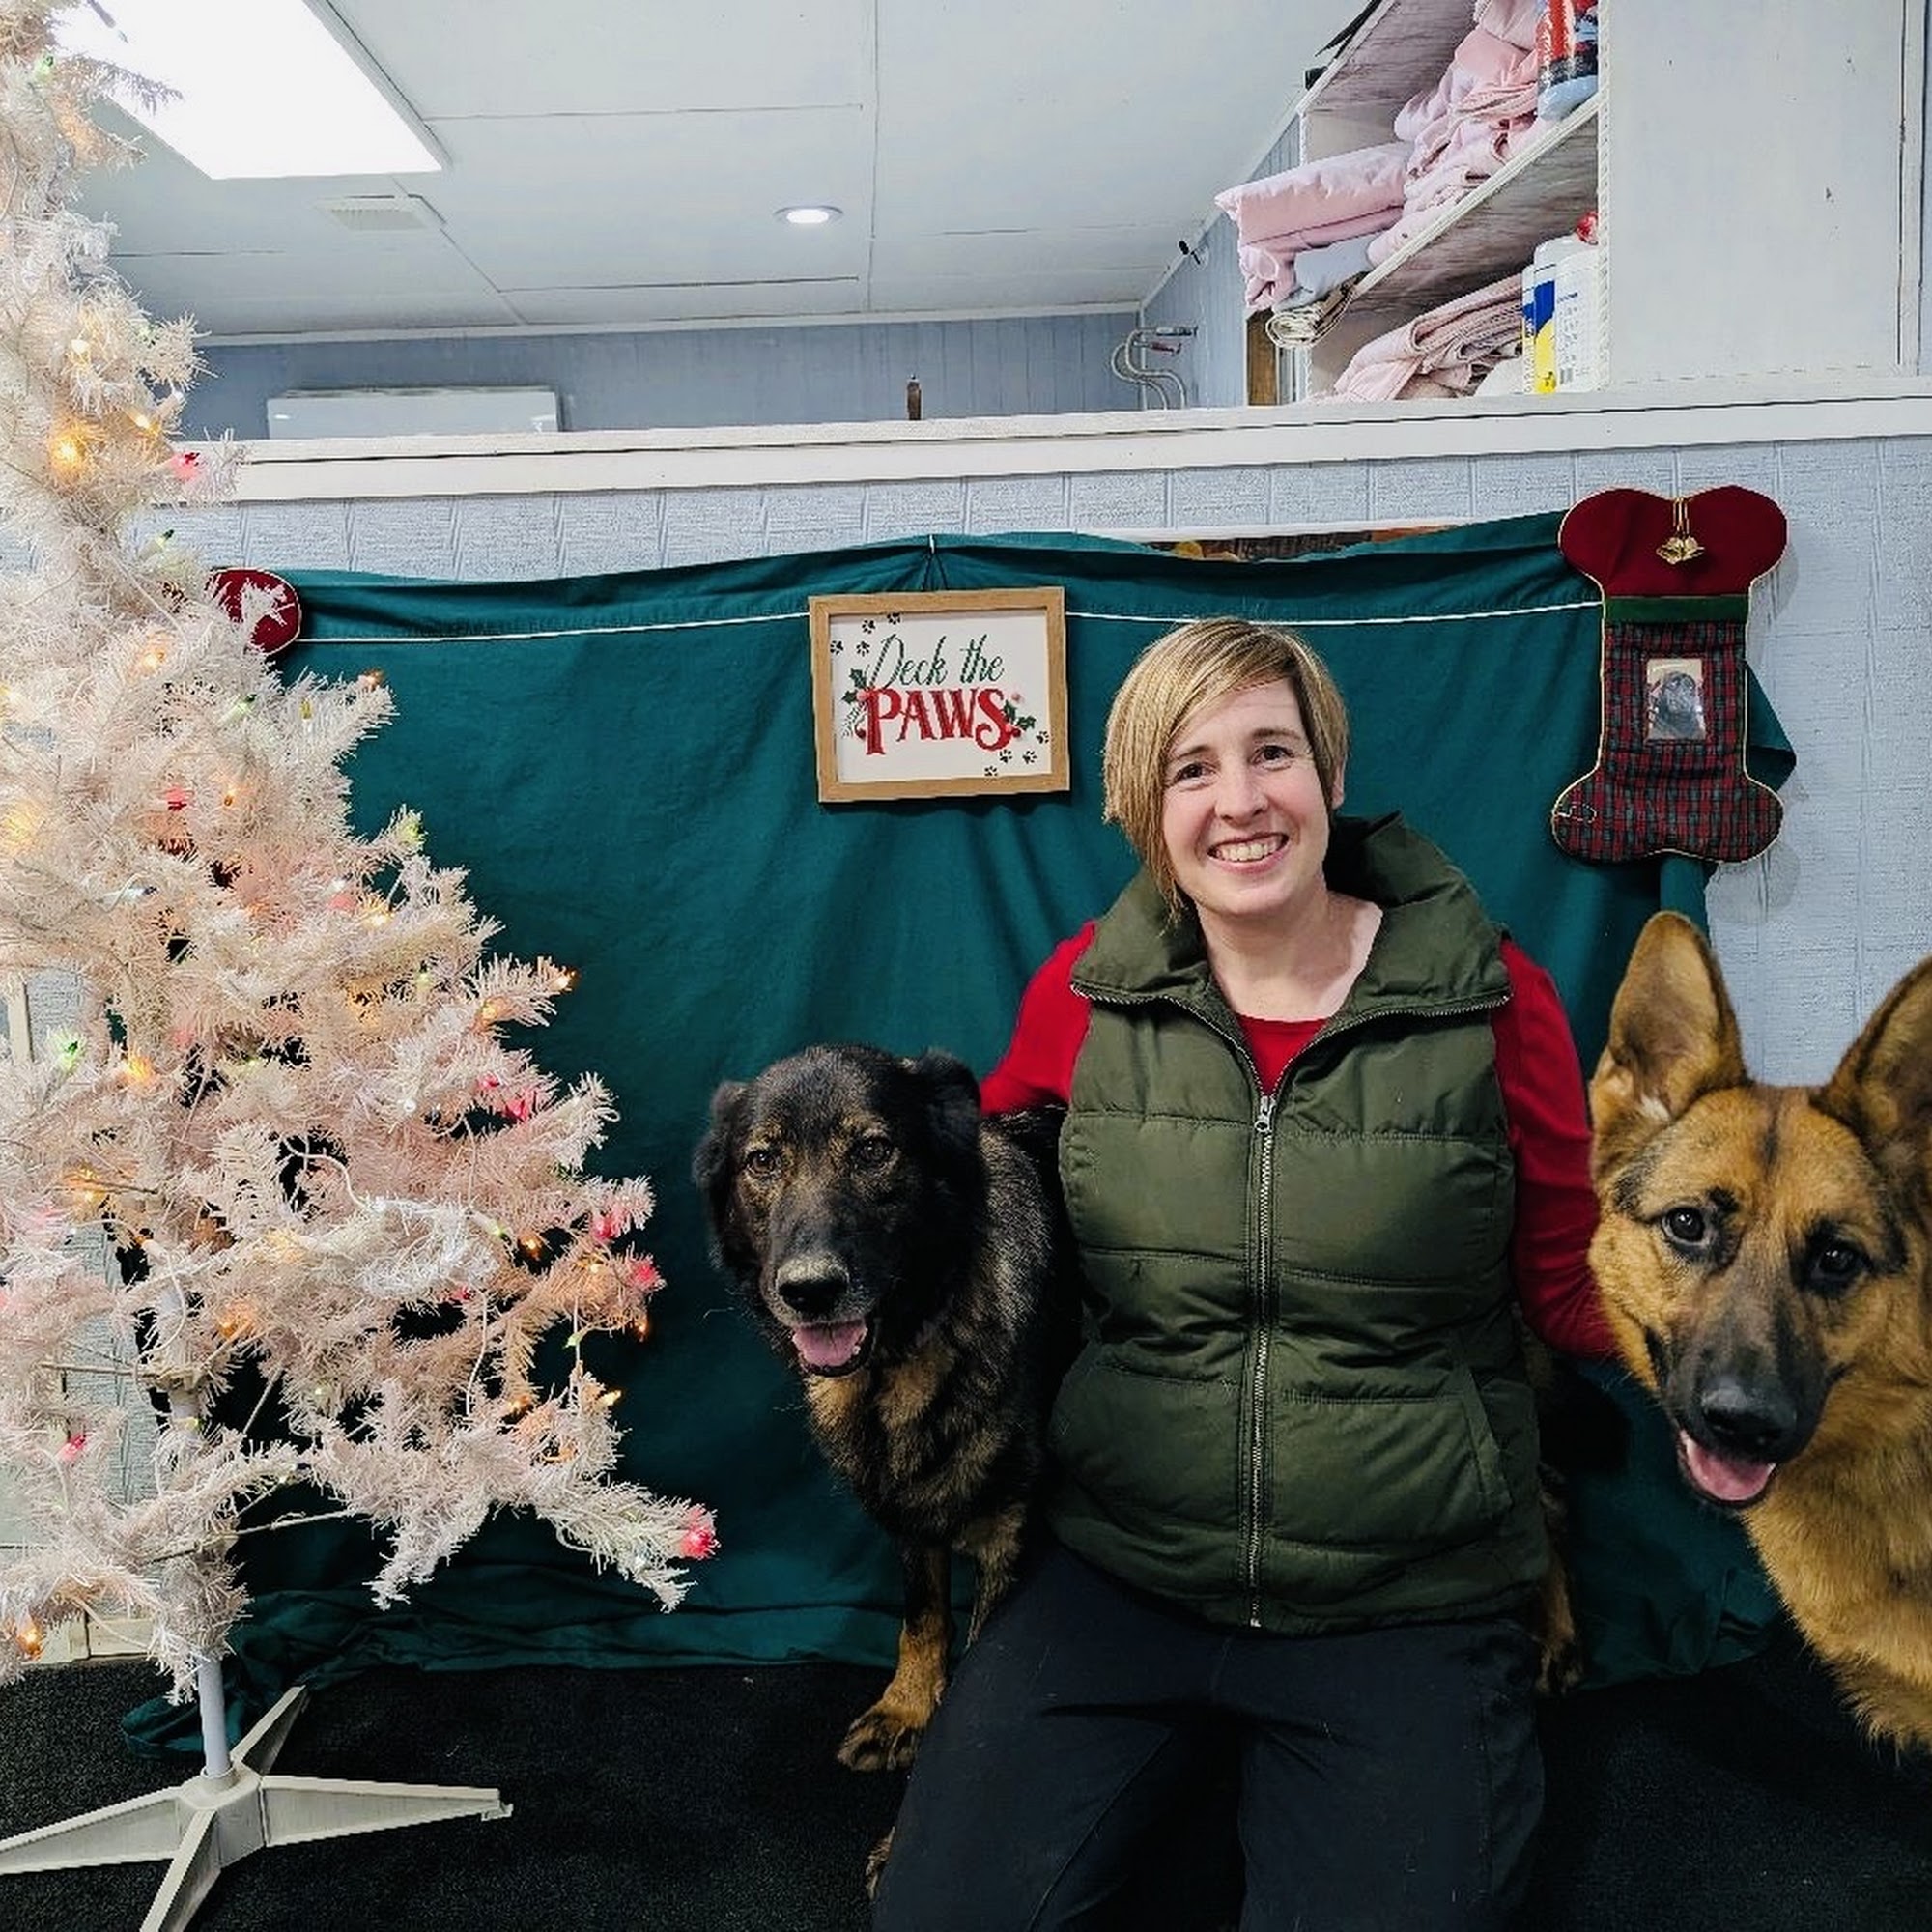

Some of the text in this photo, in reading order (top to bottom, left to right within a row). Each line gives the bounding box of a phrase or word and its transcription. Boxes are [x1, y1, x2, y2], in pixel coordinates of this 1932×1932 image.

[866, 634, 1005, 689] Deck the
[856, 687, 1014, 755] PAWS
